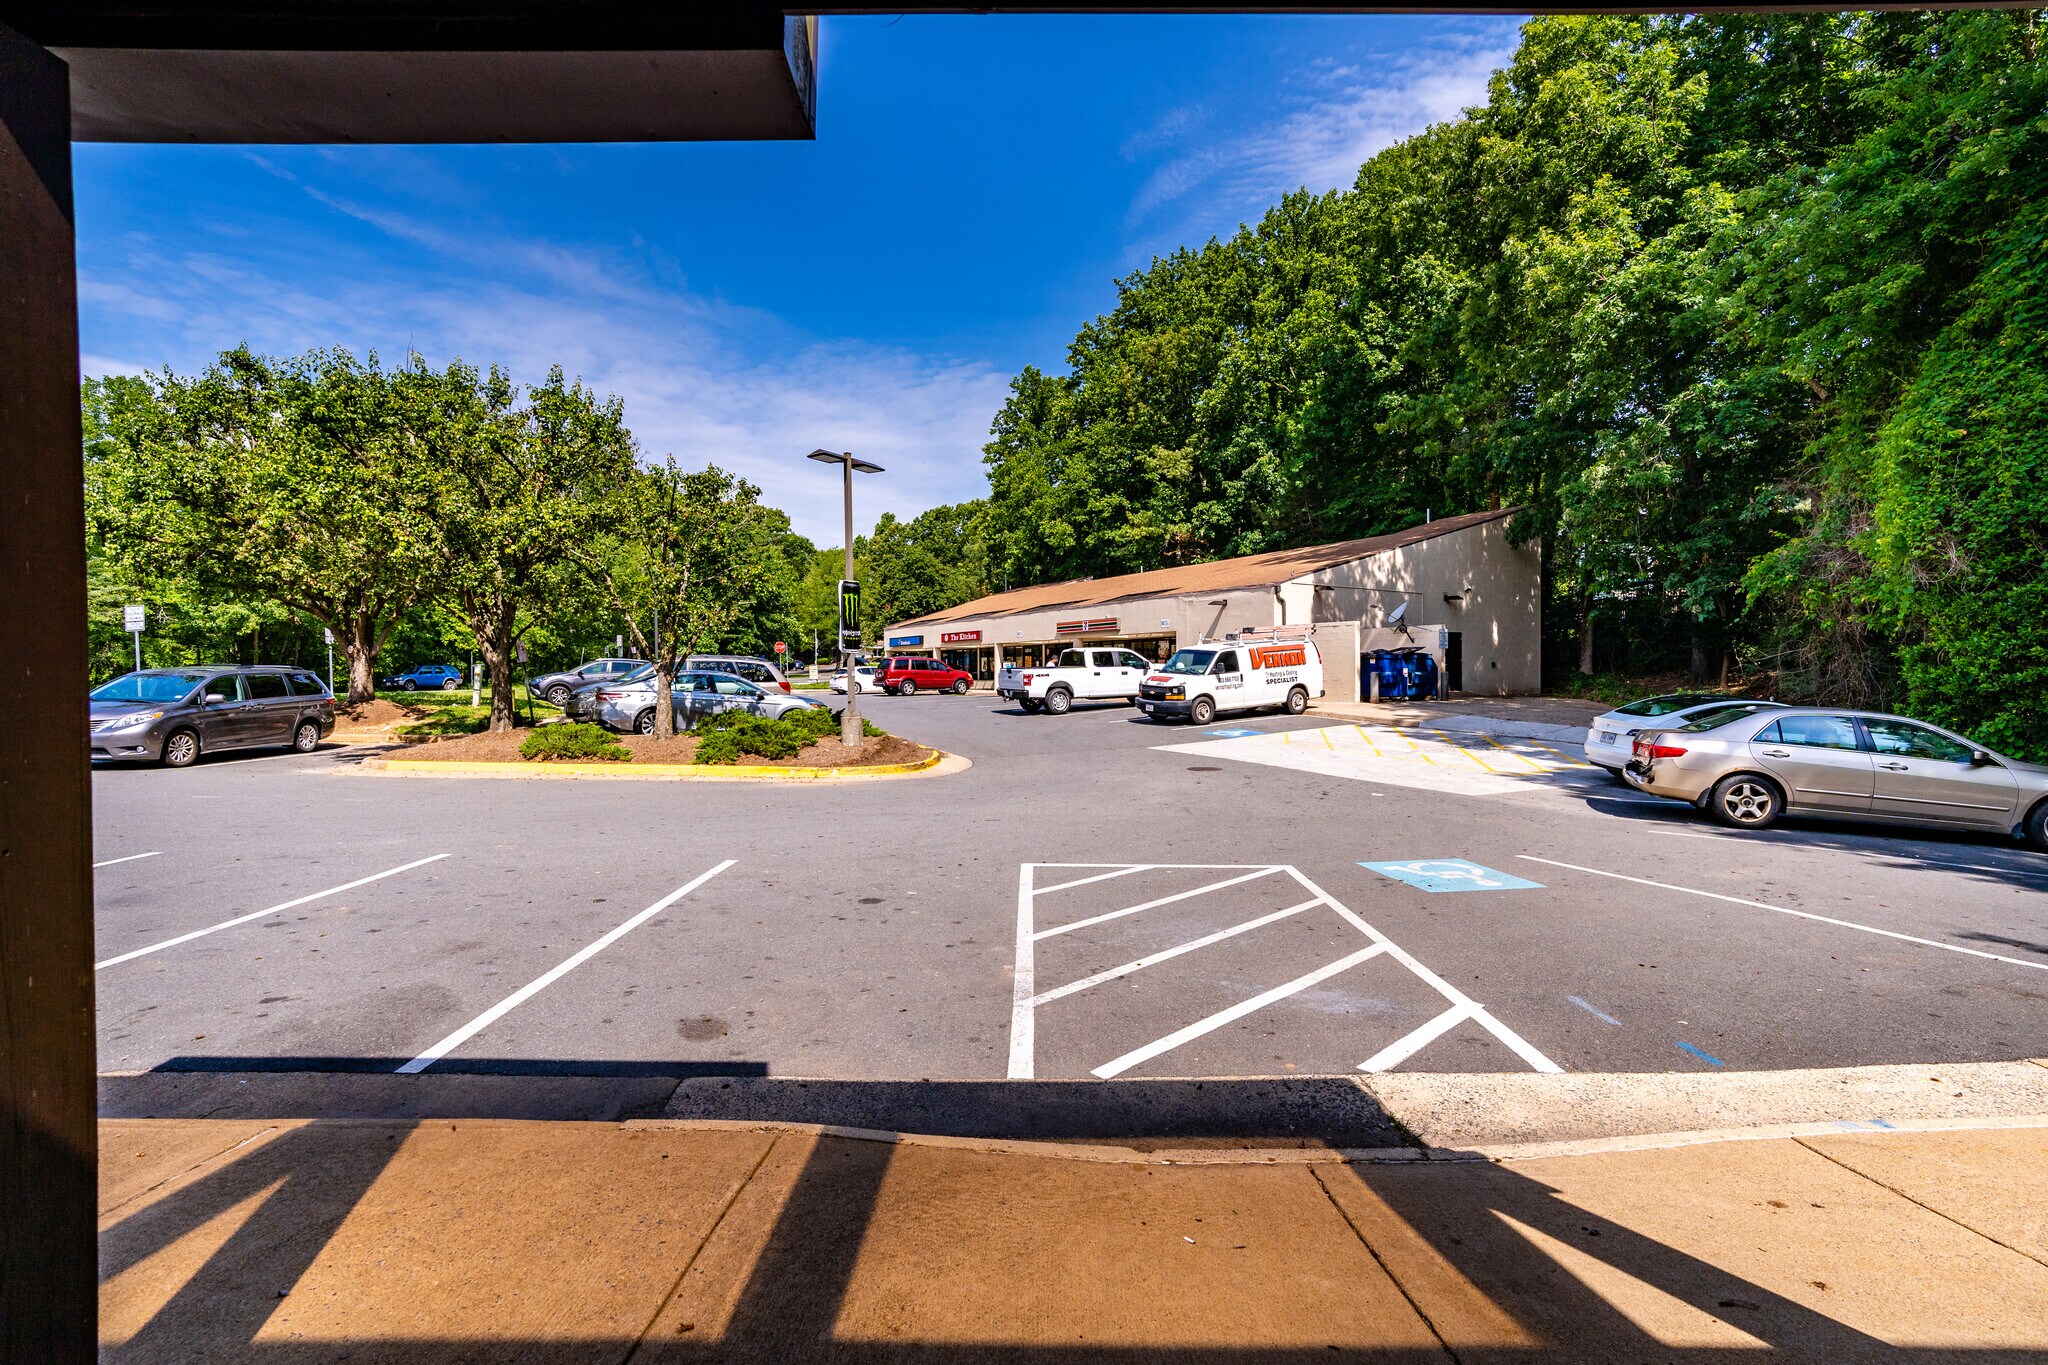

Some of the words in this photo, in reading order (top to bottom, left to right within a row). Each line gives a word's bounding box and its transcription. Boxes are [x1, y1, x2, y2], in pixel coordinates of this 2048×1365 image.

[959, 633, 977, 641] Kitchen
[1249, 644, 1306, 670] VERNON
[1266, 677, 1298, 685] SPECIALIST
